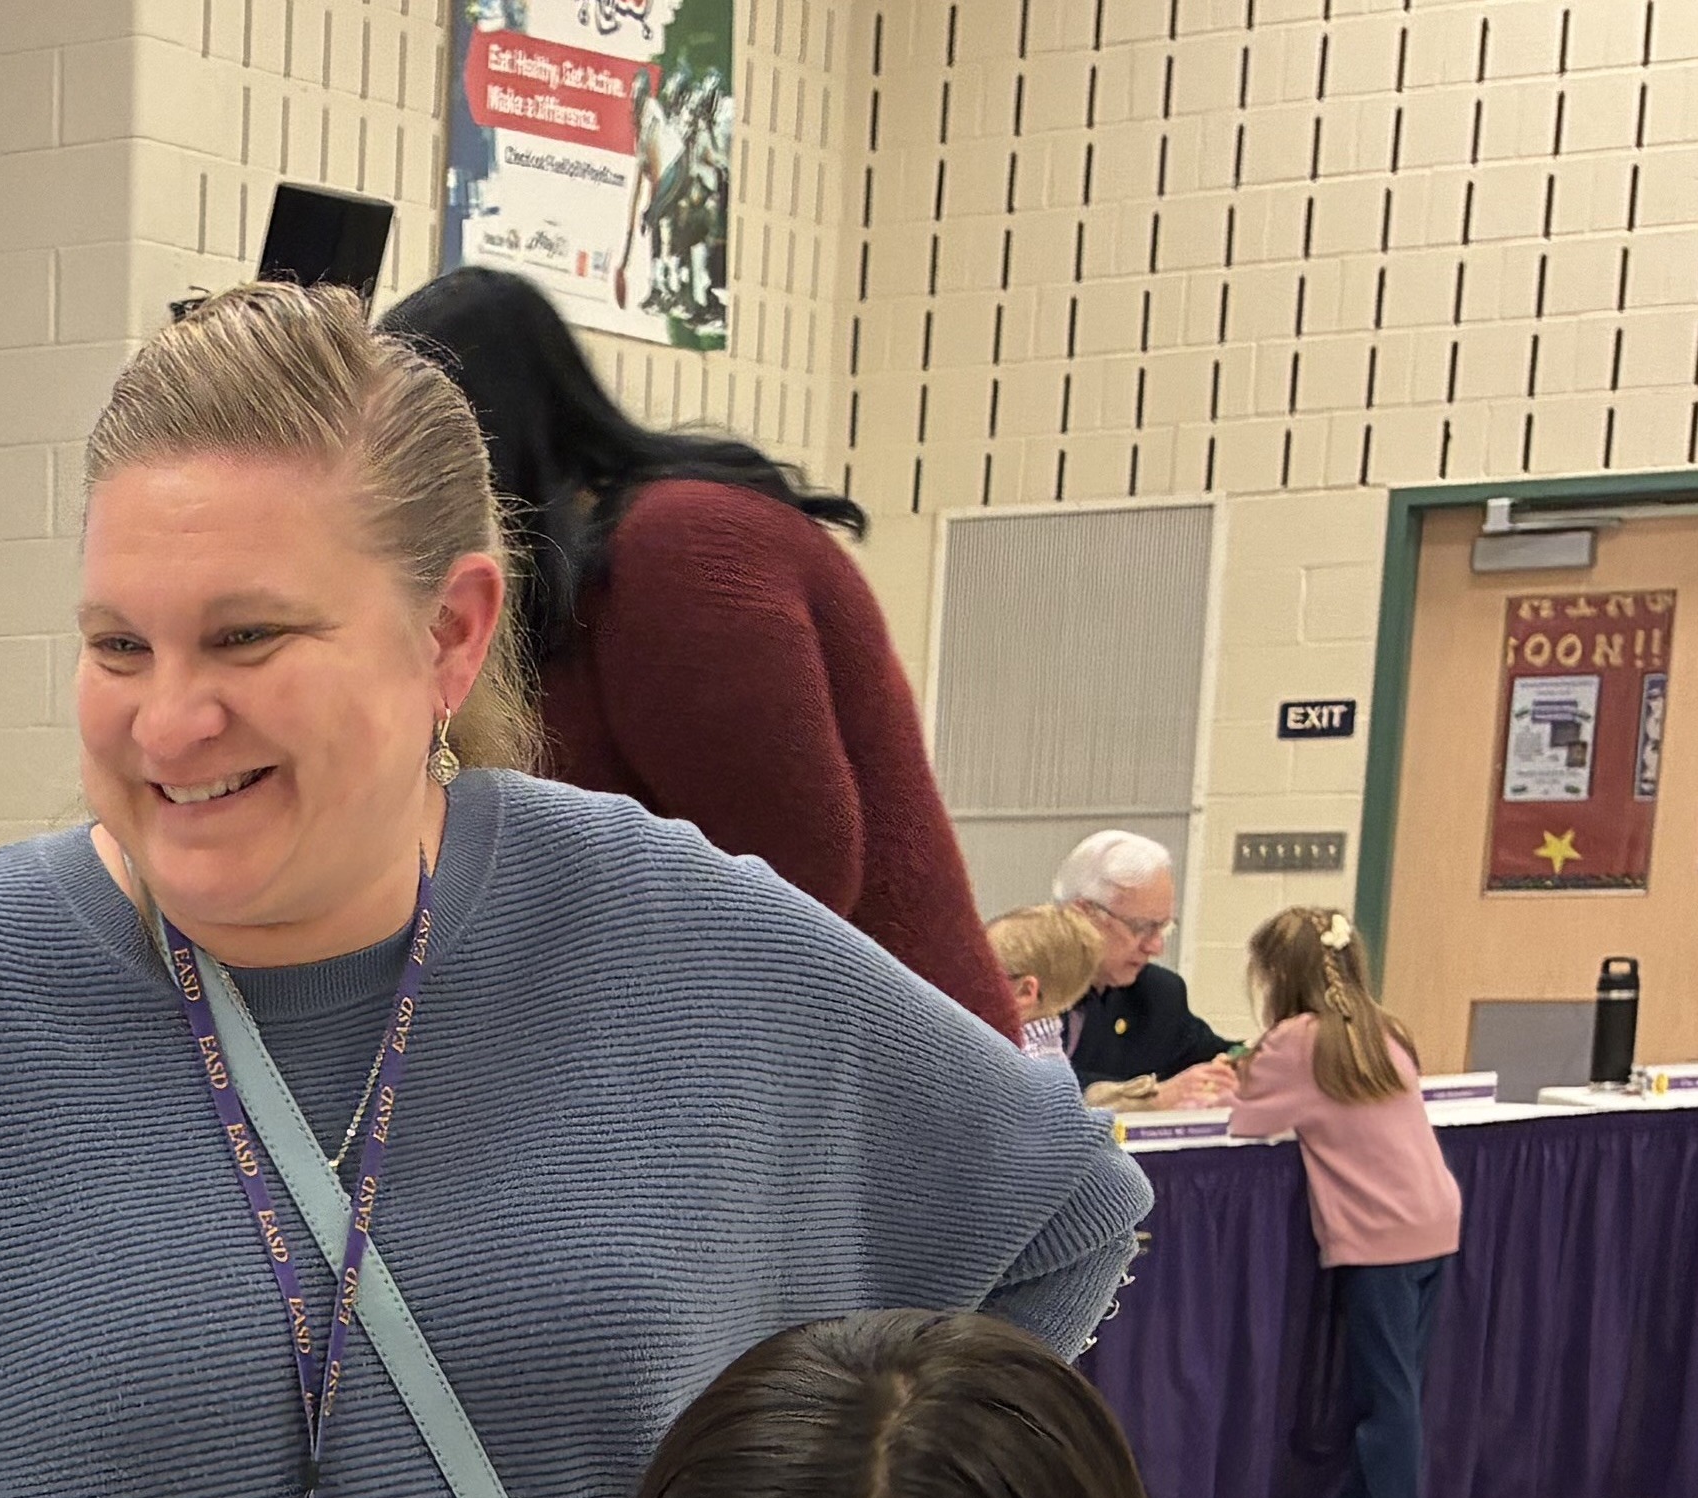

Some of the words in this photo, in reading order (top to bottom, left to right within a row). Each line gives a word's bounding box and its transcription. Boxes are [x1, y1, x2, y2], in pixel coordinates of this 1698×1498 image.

[486, 84, 522, 116] Make
[1286, 704, 1349, 730] EXIT
[173, 947, 201, 1002] EASD
[393, 996, 415, 1054] EASD
[199, 1034, 228, 1090] EASD
[373, 1085, 395, 1144] EASD
[227, 1122, 259, 1177] EASD
[355, 1176, 377, 1234] EASD
[258, 1209, 289, 1264] EASD
[338, 1266, 360, 1326] EASD
[288, 1297, 311, 1354] EASD
